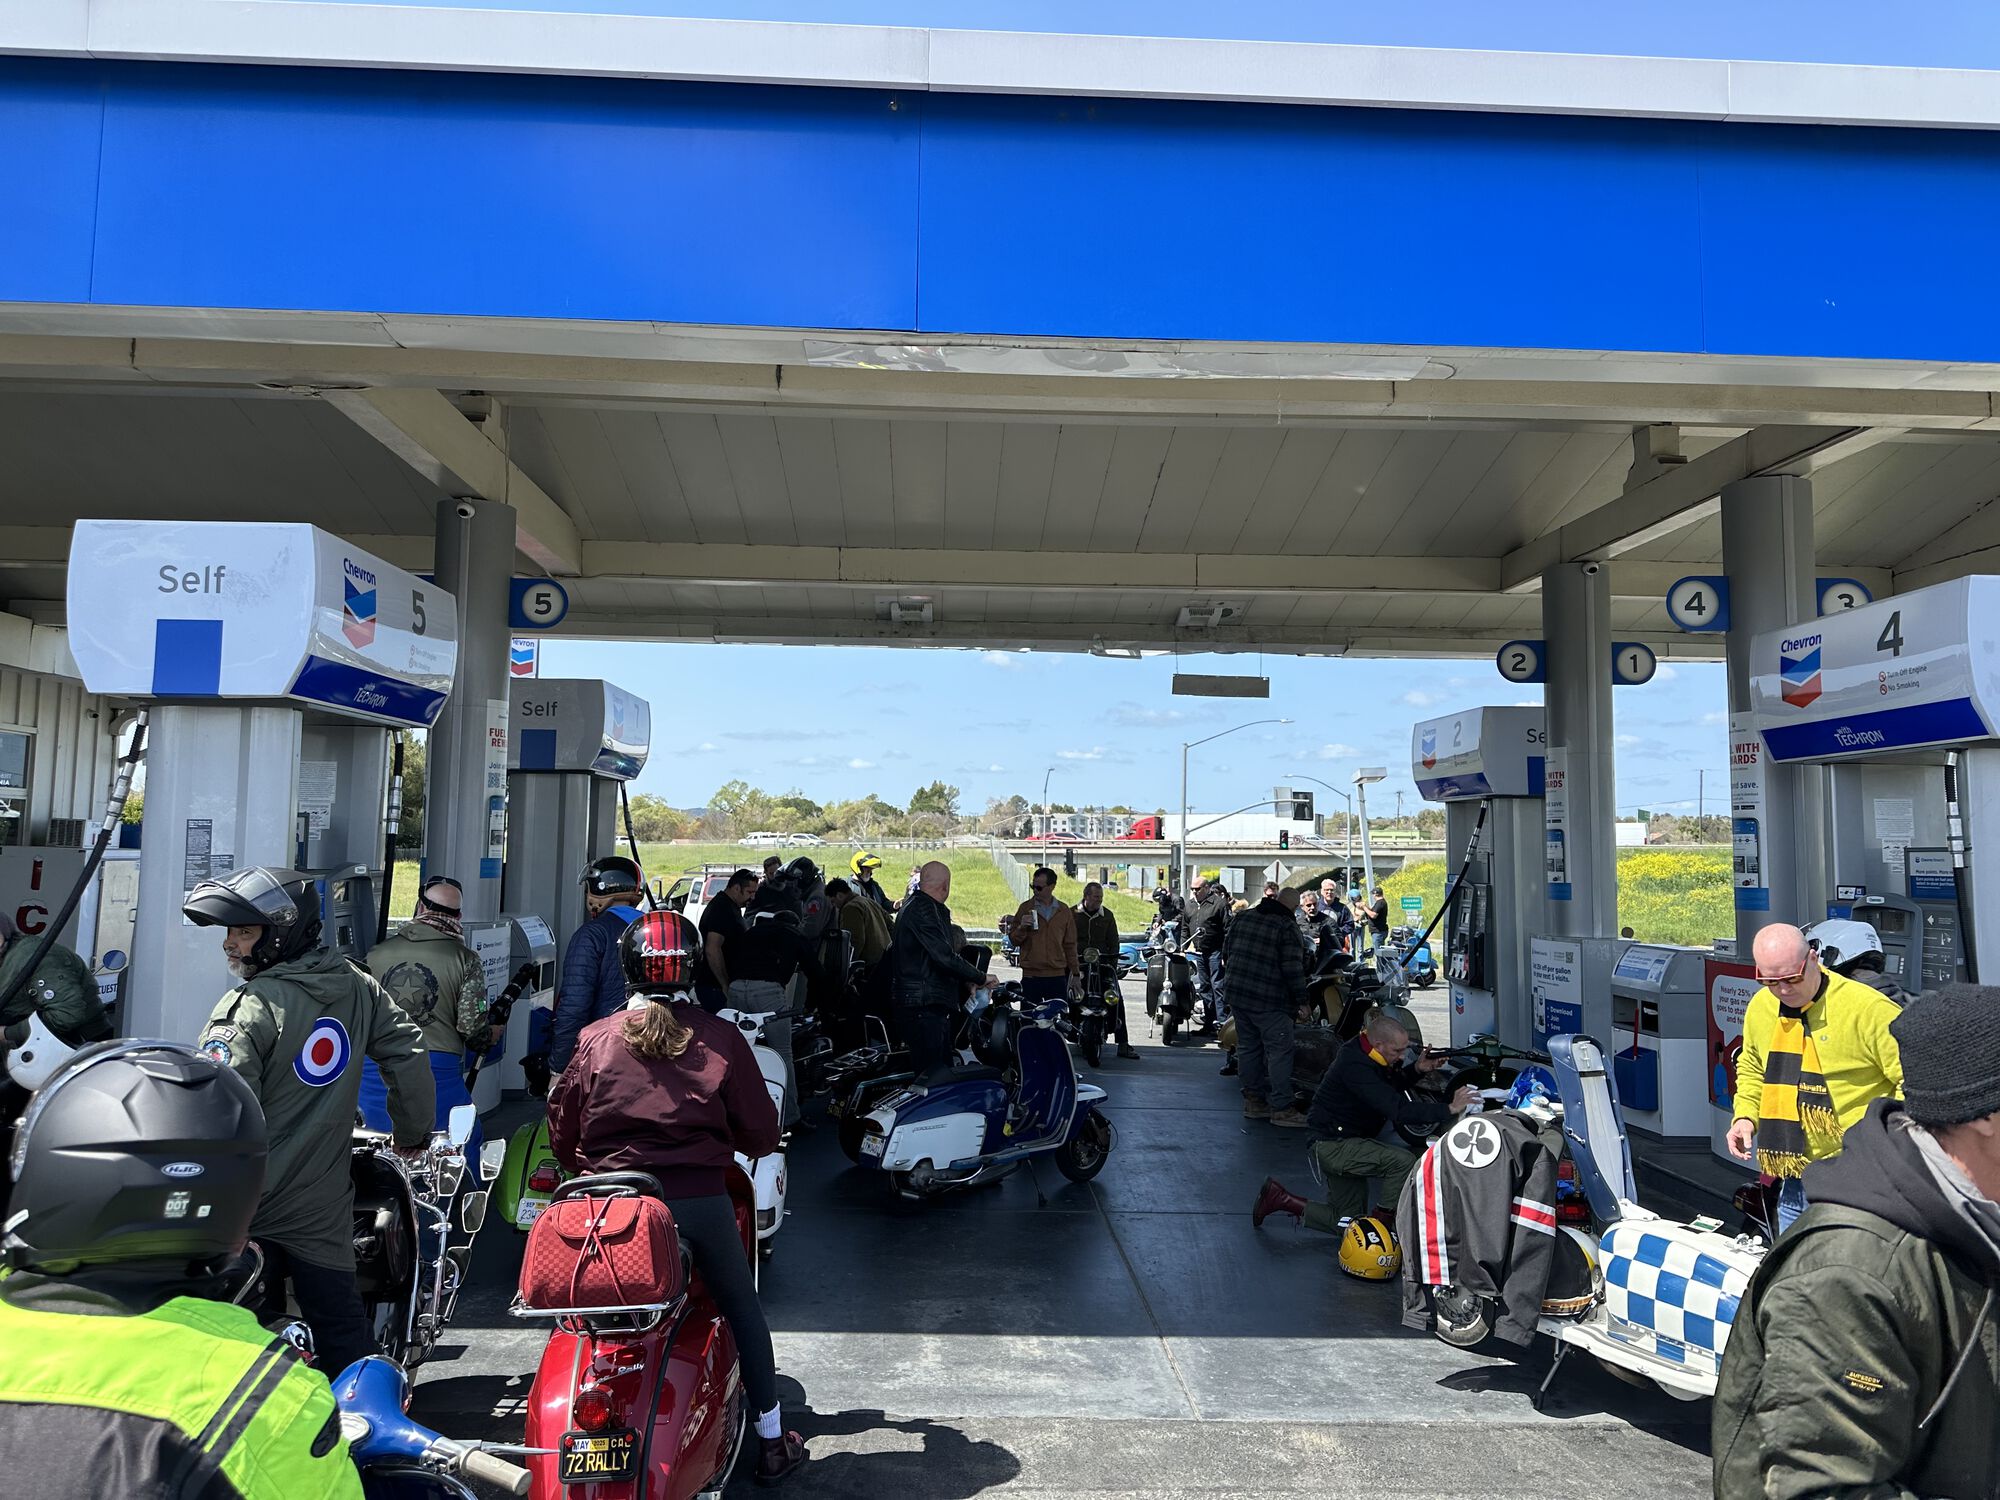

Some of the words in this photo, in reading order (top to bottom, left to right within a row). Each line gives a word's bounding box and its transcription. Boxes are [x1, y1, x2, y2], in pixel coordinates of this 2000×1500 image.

[158, 565, 226, 594] Self
[343, 557, 376, 586] Chevron
[534, 592, 552, 615] 5
[1684, 591, 1706, 616] 4
[412, 589, 427, 635] 5
[1877, 610, 1904, 657] 4
[1781, 634, 1822, 653] Chevron
[1511, 652, 1527, 672] 2
[1629, 654, 1638, 673] 1
[1896, 680, 1920, 690] Smoking
[521, 701, 558, 717] Self
[1453, 721, 1462, 748] 2
[1526, 728, 1545, 743] Se
[1834, 730, 1885, 746] TECHRON
[1837, 725, 1852, 735] with
[1735, 743, 1760, 754] WITH
[641, 941, 688, 957] Vespa
[1738, 989, 1751, 997] 25%
[1730, 998, 1740, 1006] gas
[165, 1200, 190, 1211] DOT
[617, 1363, 645, 1376] Rally
[573, 1440, 590, 1450] MAY
[566, 1453, 584, 1473] 72
[586, 1450, 630, 1472] RALLY
